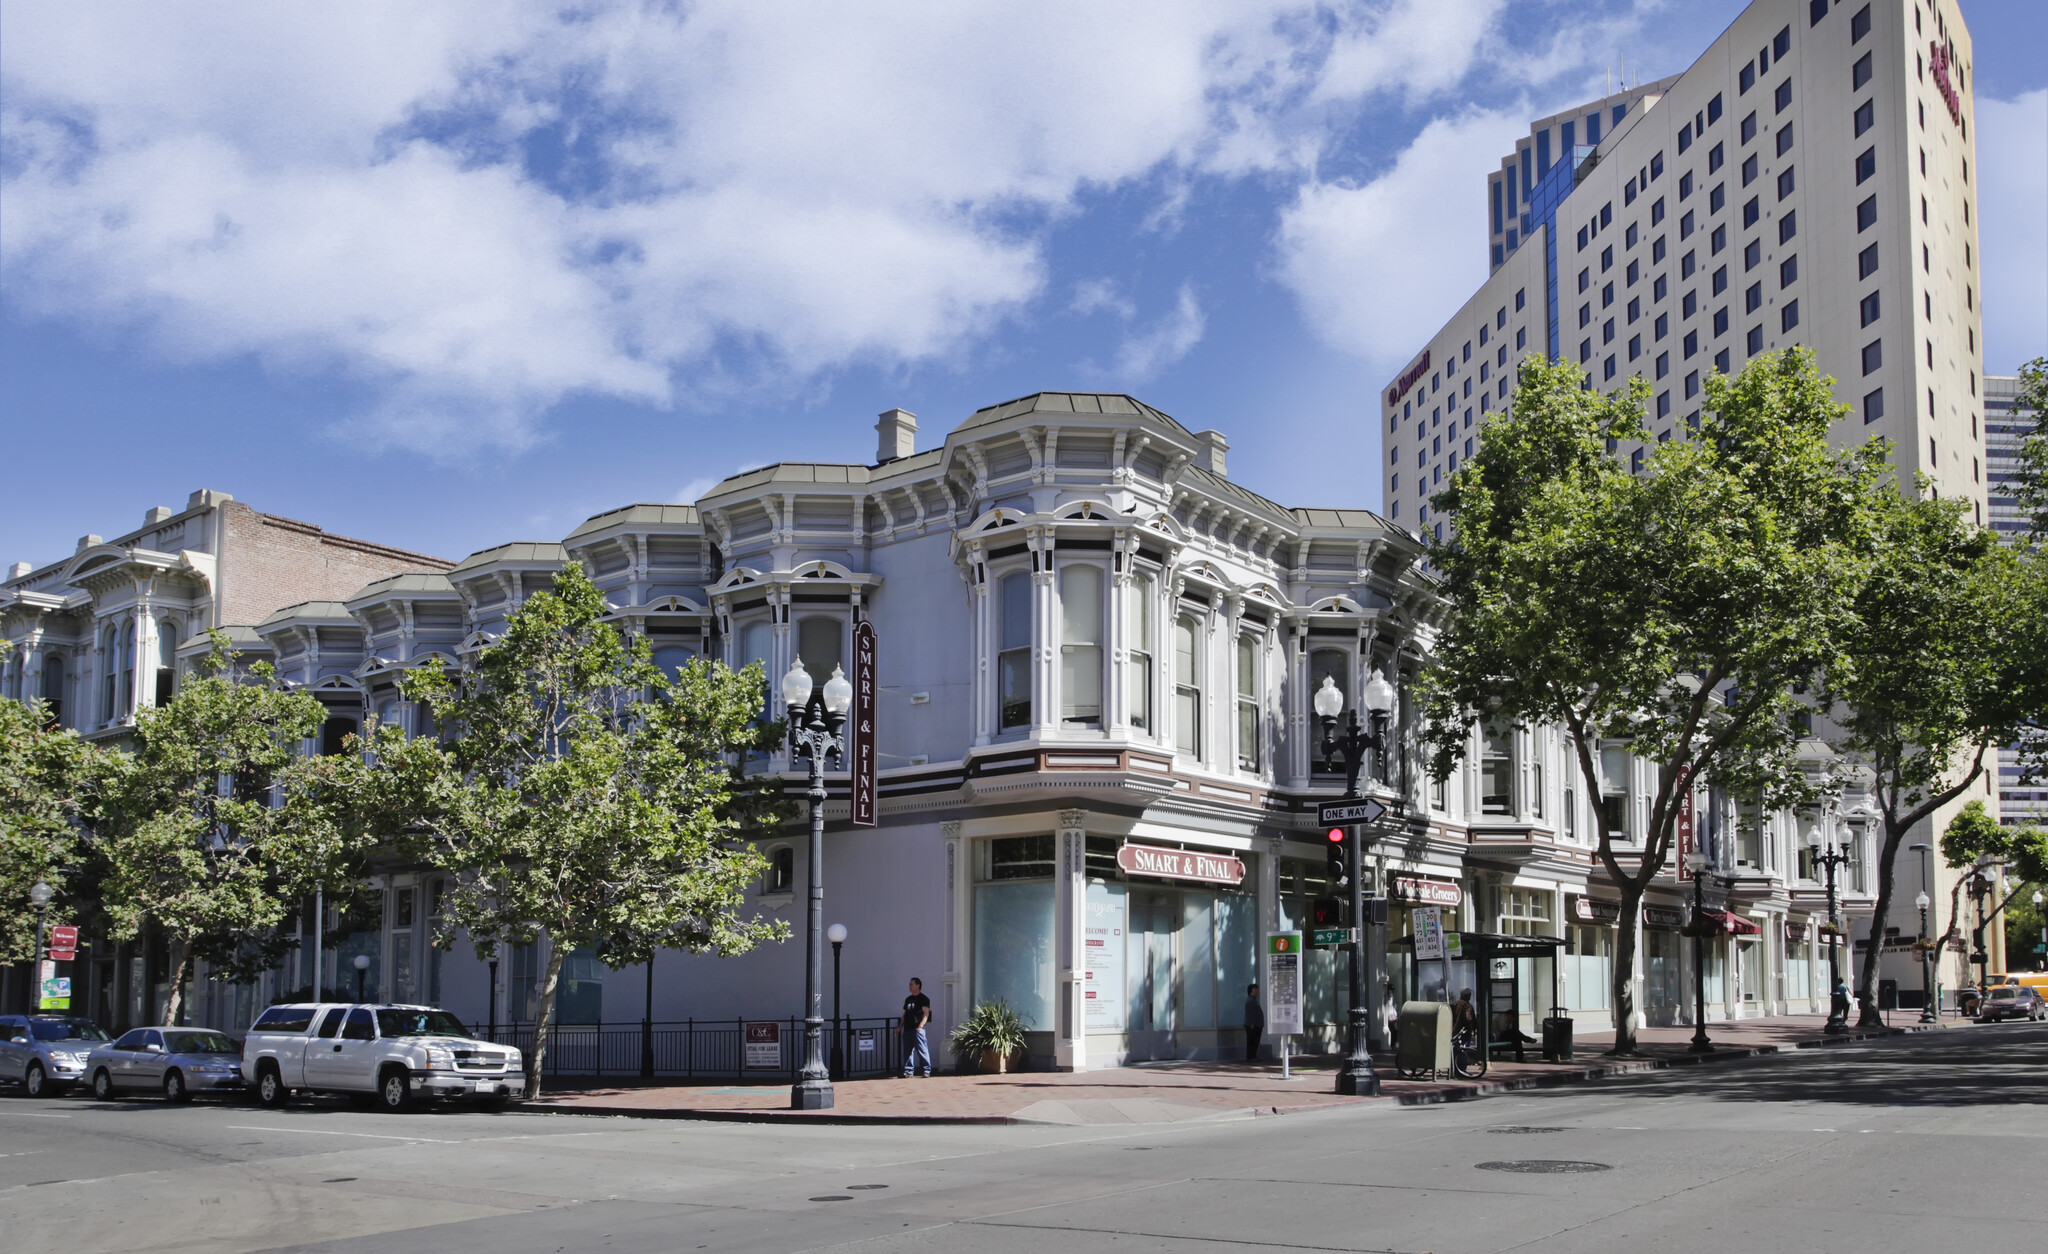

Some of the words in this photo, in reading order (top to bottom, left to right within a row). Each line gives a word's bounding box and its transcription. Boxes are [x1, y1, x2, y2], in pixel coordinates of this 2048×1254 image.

[860, 636, 872, 709] SMART
[860, 720, 871, 733] &
[860, 745, 871, 818] FINAL
[1325, 808, 1344, 819] ONE
[1347, 806, 1366, 818] WAY
[1681, 821, 1690, 830] &
[1135, 849, 1180, 873] SMART
[1183, 857, 1193, 875] &
[1196, 856, 1231, 879] FINAL
[1431, 885, 1458, 901] Grocers
[1085, 927, 1108, 935] ELCOME!
